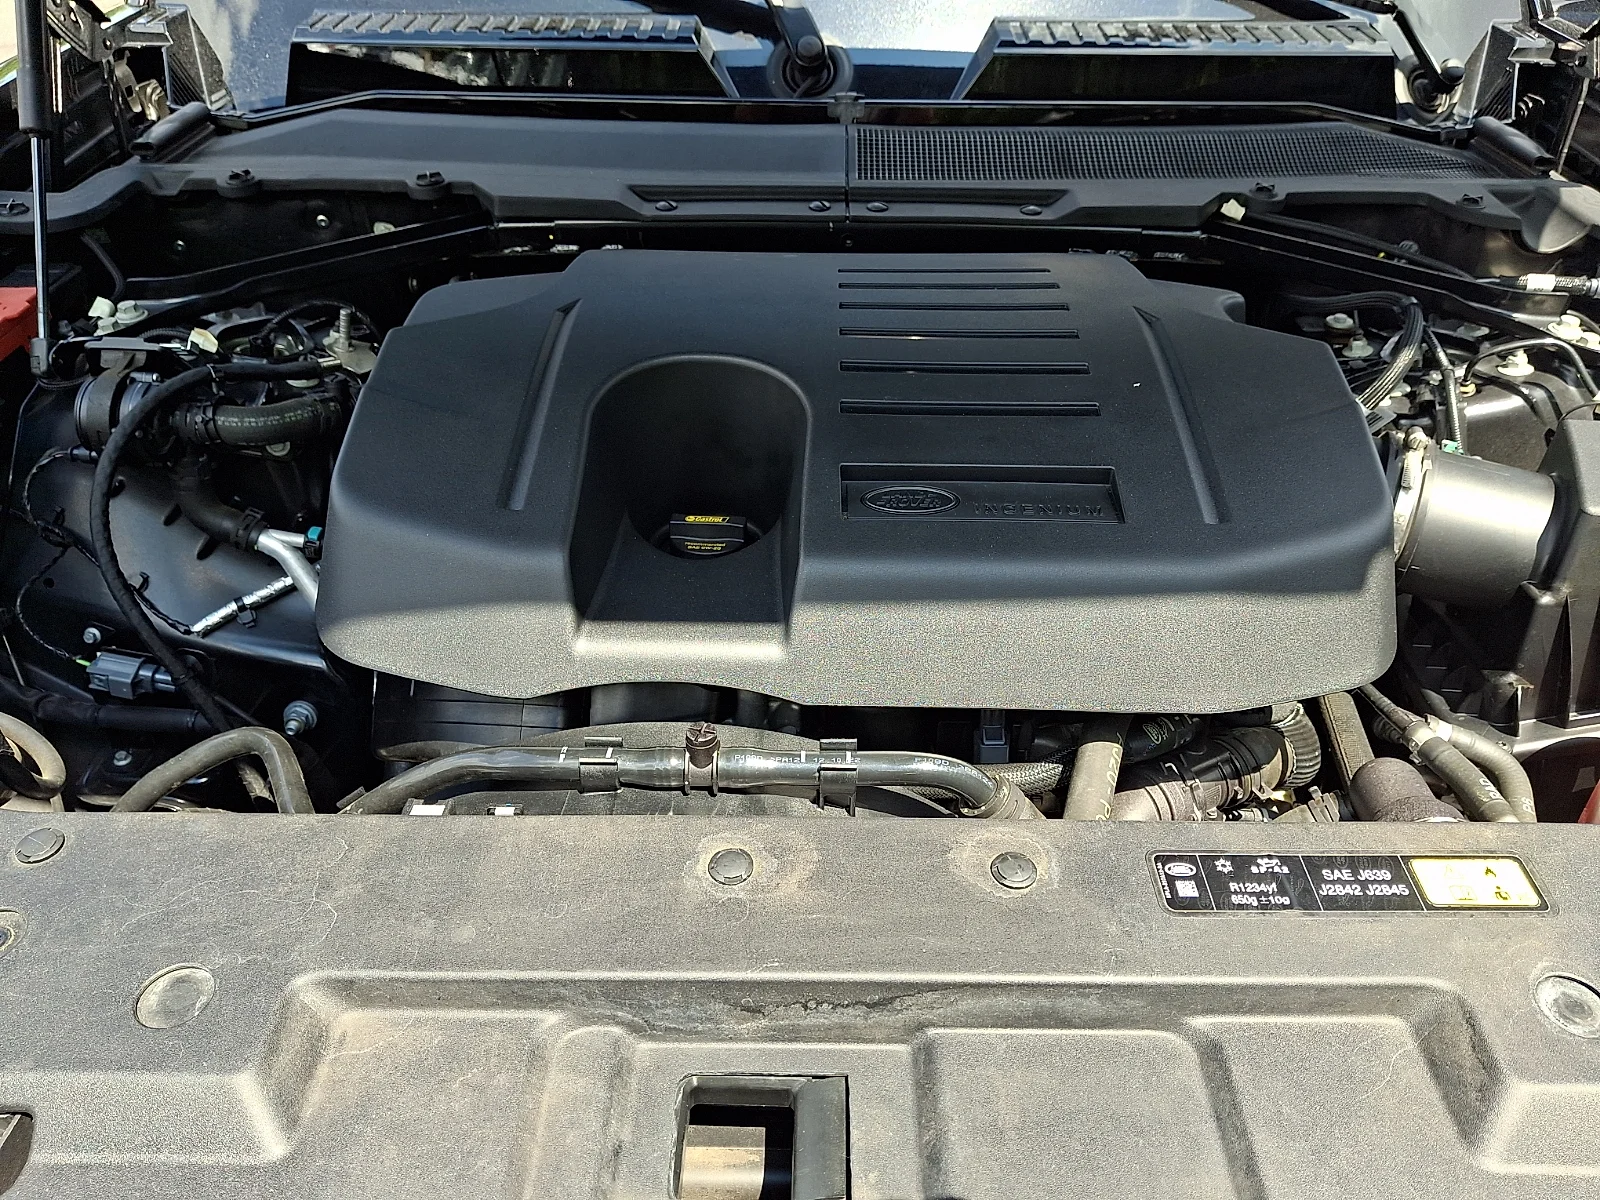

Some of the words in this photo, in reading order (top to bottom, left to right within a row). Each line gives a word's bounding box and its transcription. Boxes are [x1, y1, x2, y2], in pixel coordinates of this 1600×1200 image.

[973, 503, 1104, 517] INGENIUM
[1321, 869, 1355, 881] SAE
[1357, 869, 1392, 881] J639
[1318, 884, 1364, 896] J2842
[1365, 884, 1410, 896] J2845
[1231, 894, 1259, 906] 650g
